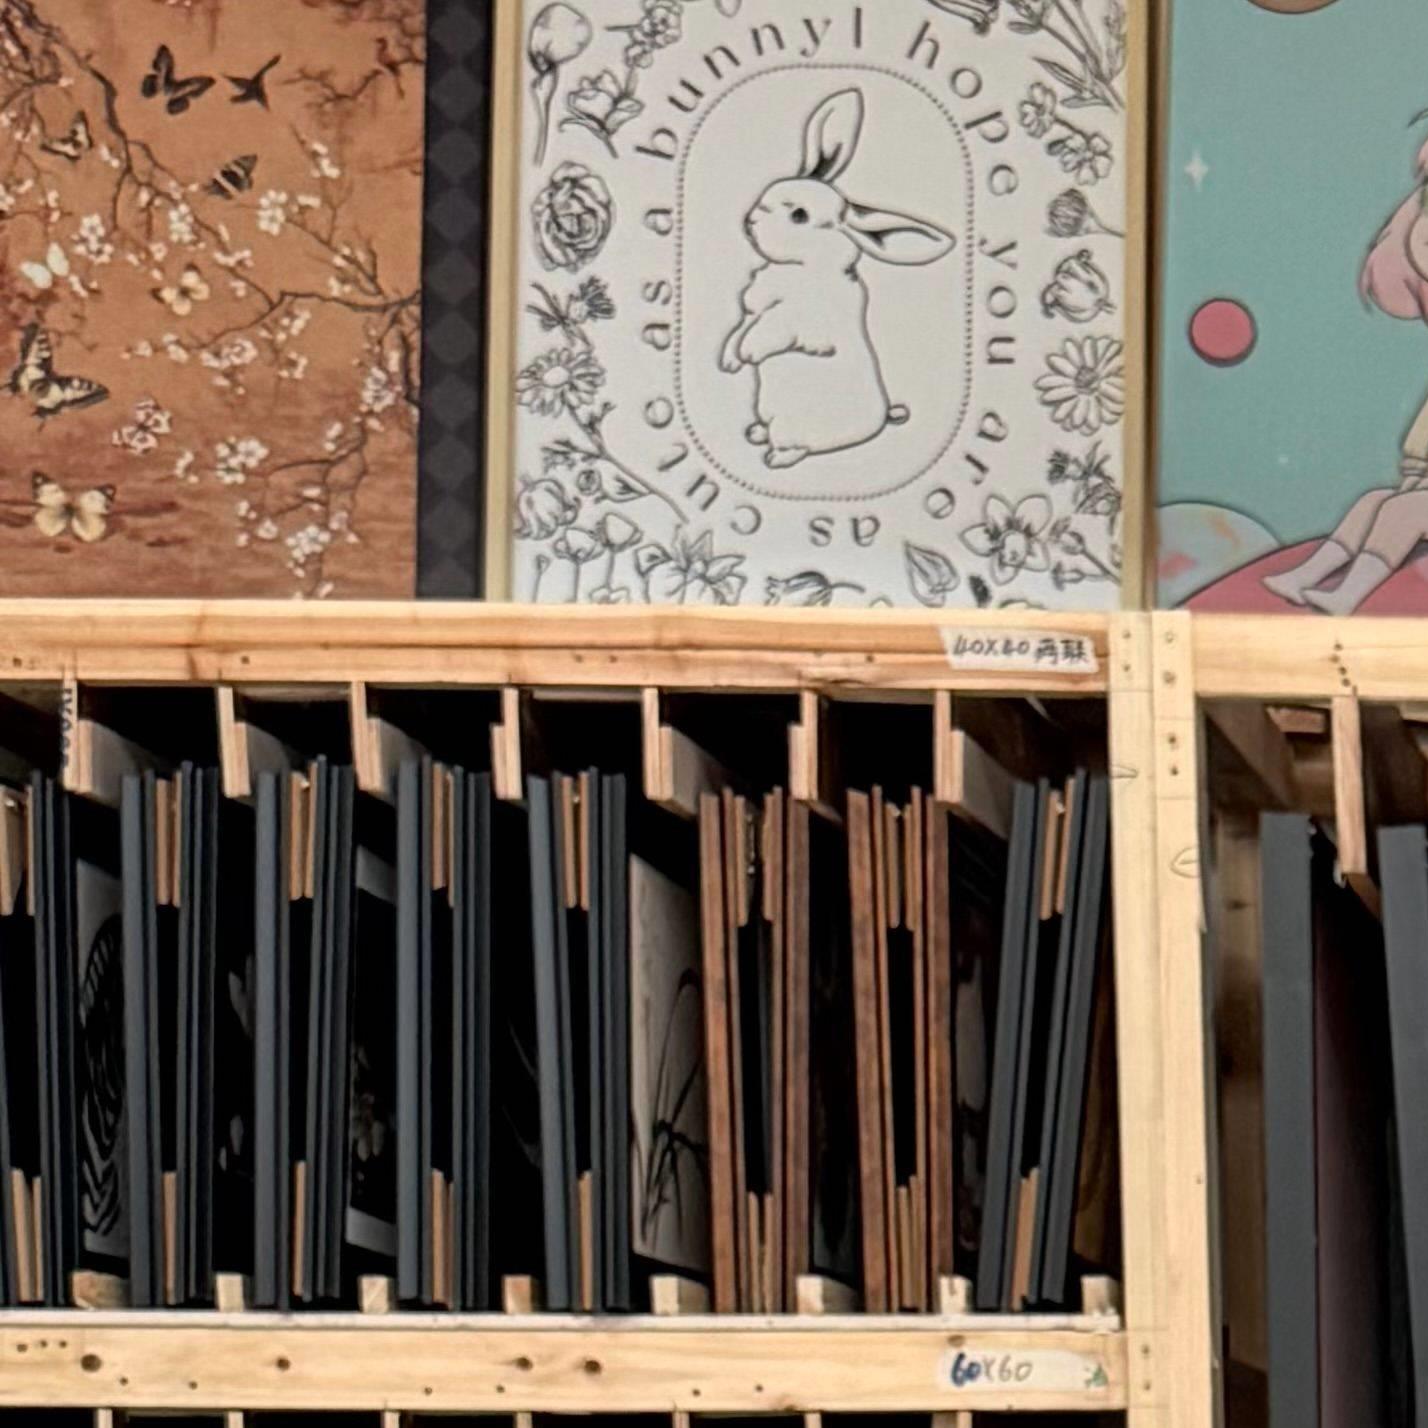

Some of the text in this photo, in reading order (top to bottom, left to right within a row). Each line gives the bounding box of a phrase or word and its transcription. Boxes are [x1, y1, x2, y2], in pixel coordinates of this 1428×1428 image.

[906, 20, 1019, 197] hope
[642, 208, 674, 236] a
[642, 279, 673, 351] as
[980, 238, 1018, 366] you
[642, 397, 763, 536] cute
[924, 410, 1009, 519] are
[810, 512, 880, 547] as
